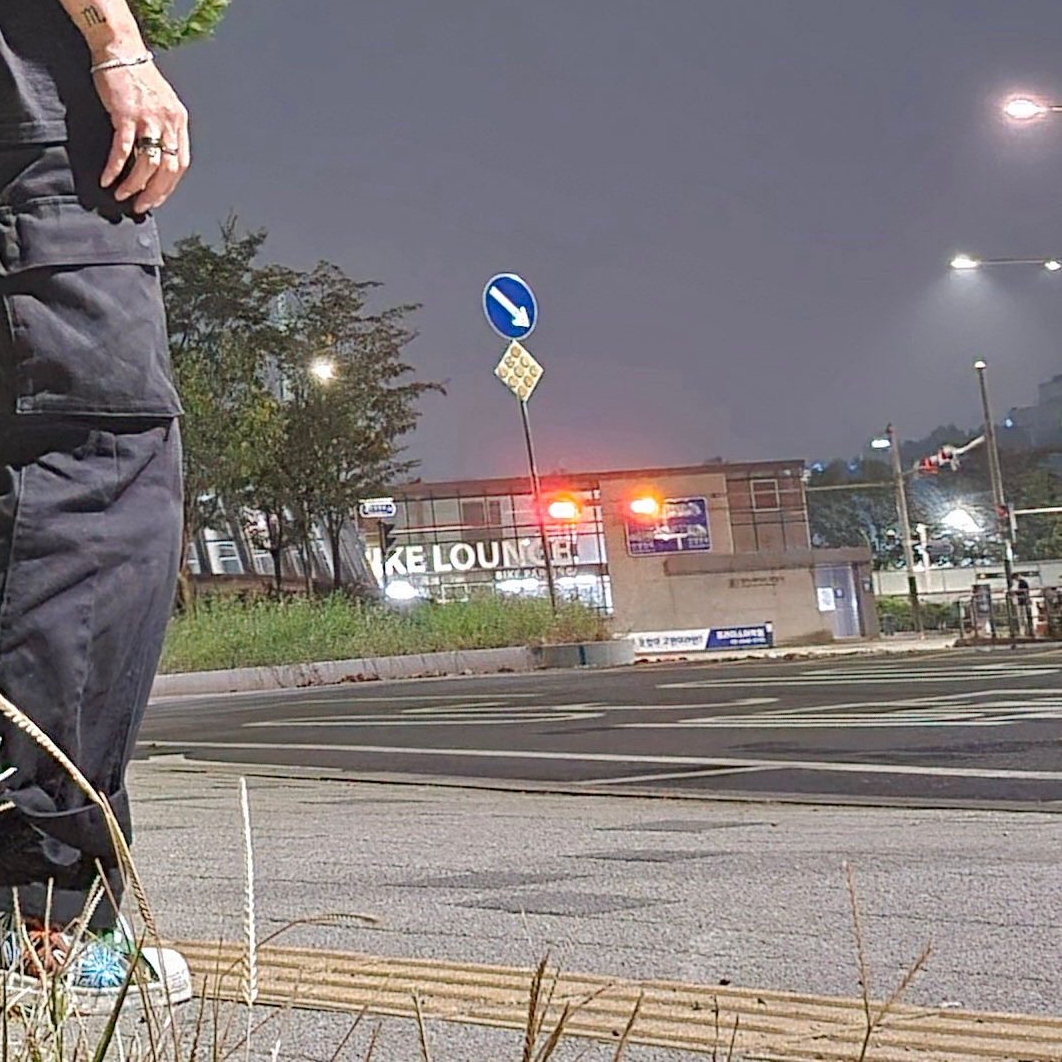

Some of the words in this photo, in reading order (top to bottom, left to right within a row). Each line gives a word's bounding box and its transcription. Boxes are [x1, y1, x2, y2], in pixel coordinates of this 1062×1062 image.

[365, 545, 426, 579] IKE
[432, 539, 574, 572] LOUNGE
[523, 567, 578, 580] PARING
